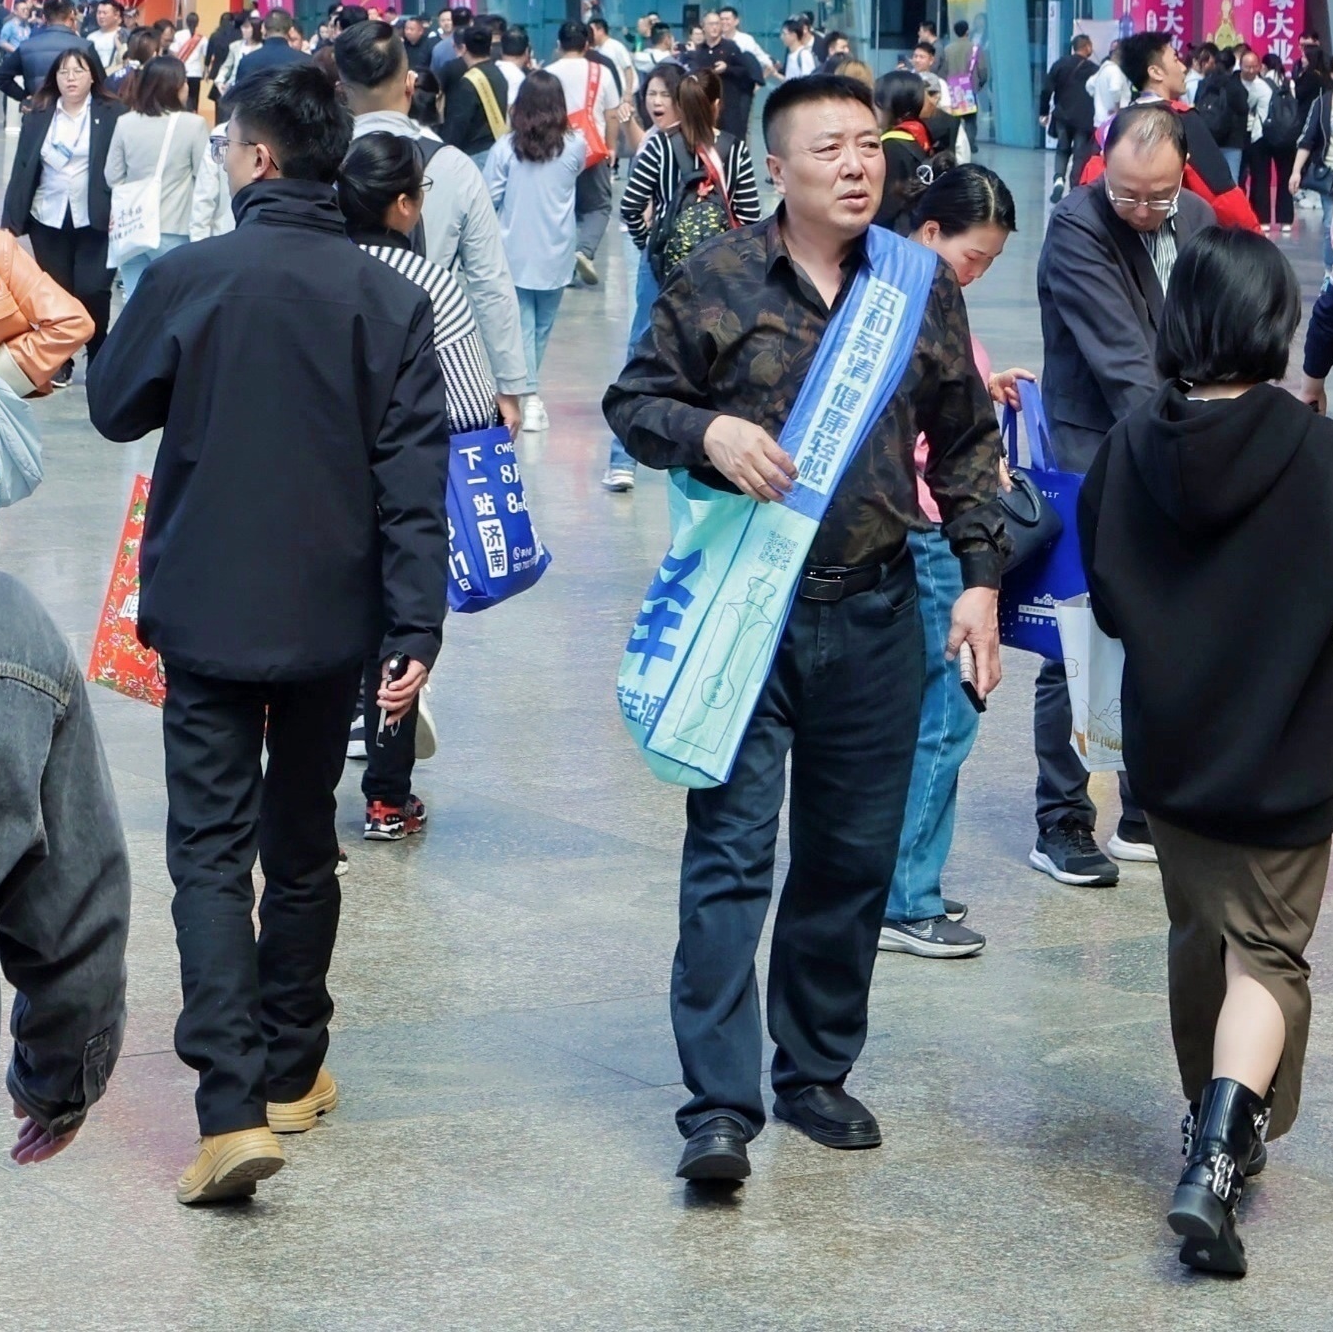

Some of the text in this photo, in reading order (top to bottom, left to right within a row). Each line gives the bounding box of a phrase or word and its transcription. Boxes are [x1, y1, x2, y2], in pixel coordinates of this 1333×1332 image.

[798, 382, 862, 487] 健康轻松
[458, 446, 496, 517] 下一站
[482, 524, 506, 573] 济南
